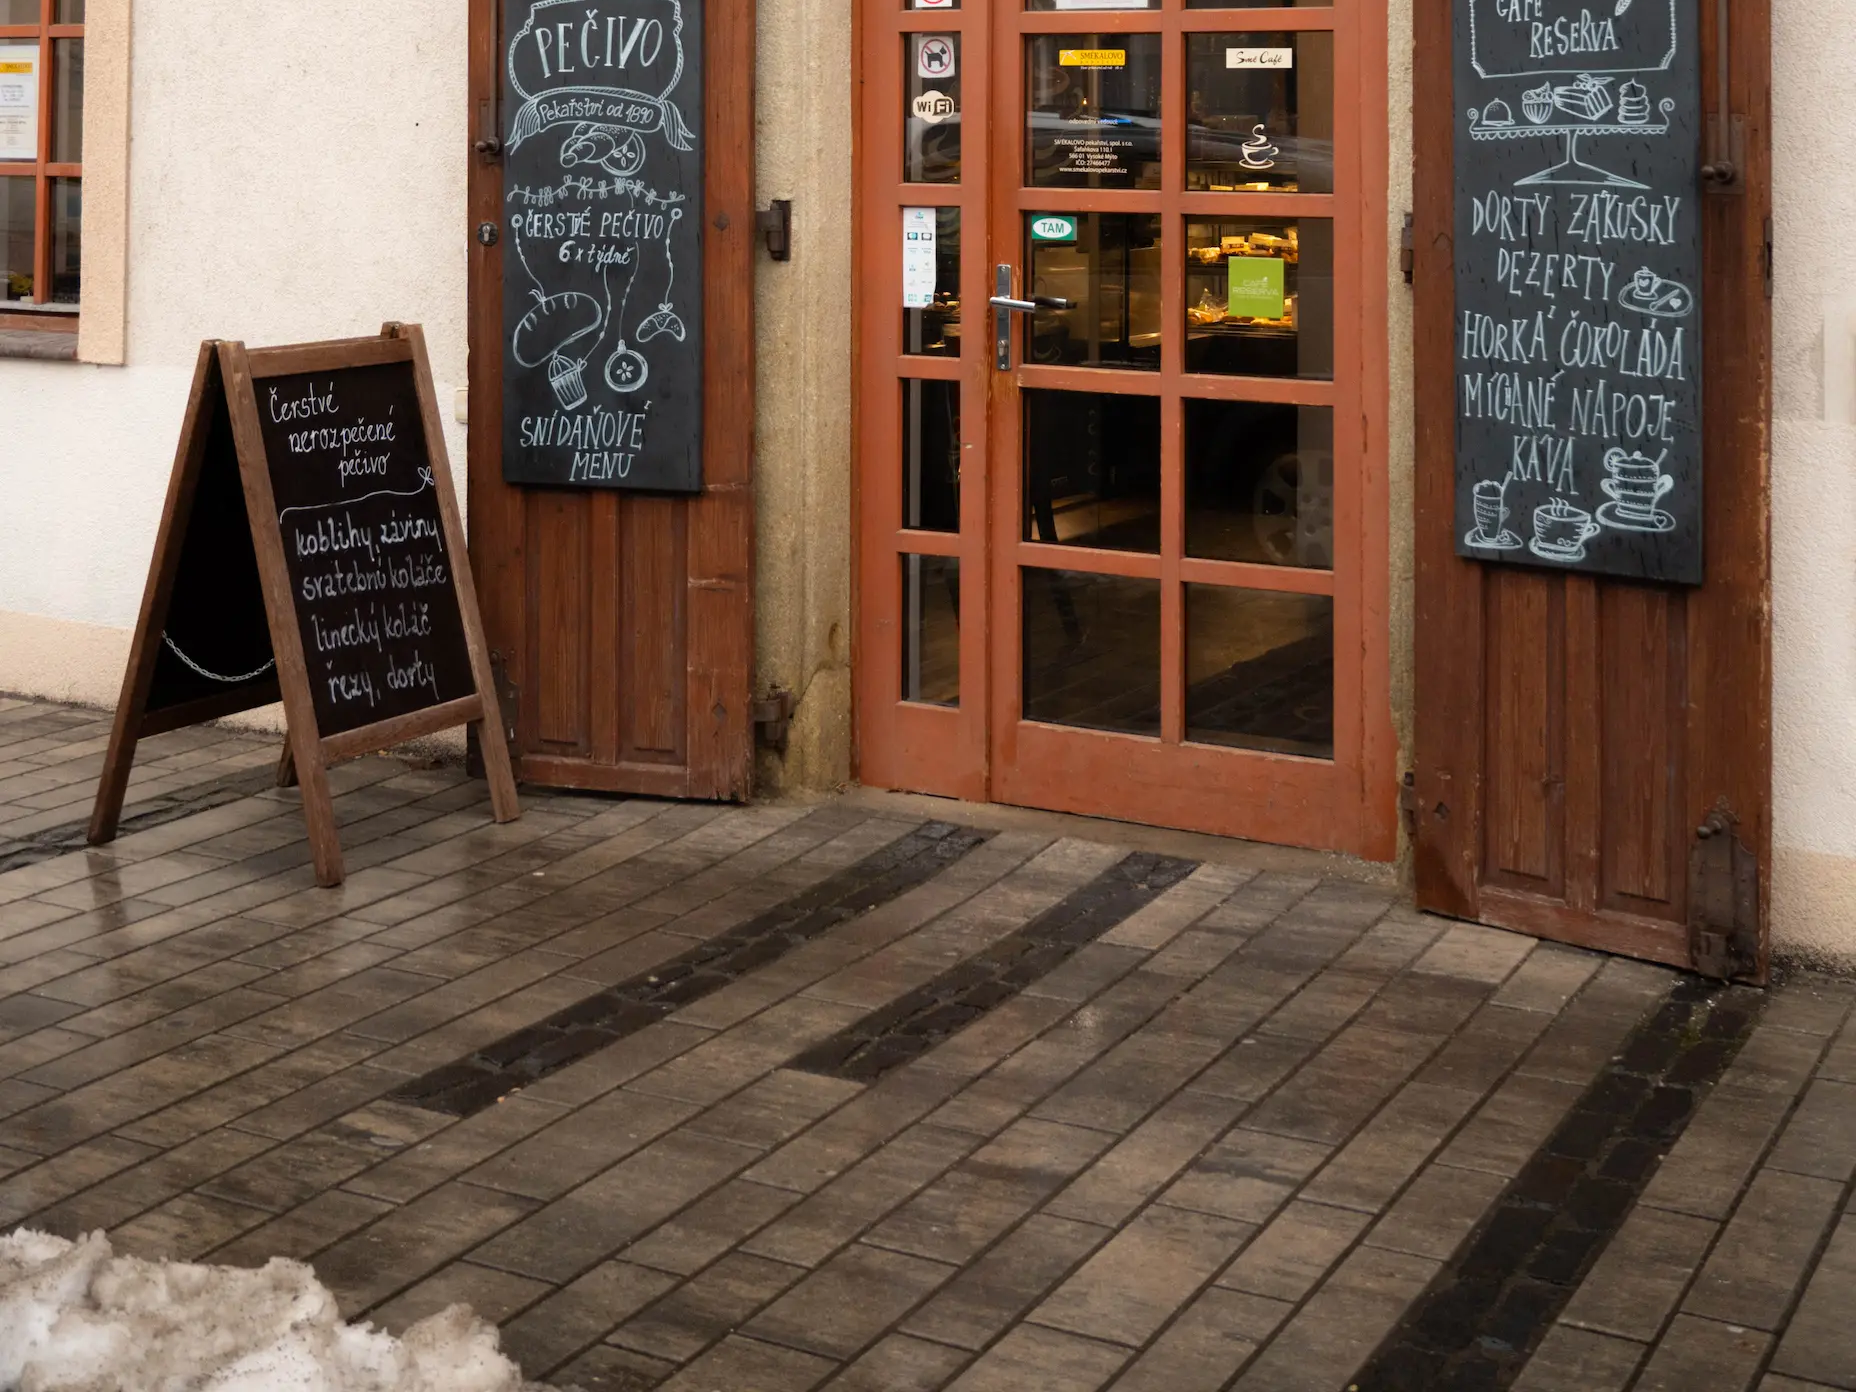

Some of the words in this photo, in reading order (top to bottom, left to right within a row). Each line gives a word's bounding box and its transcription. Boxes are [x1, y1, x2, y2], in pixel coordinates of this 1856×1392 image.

[535, 9, 663, 78] PEČIVO
[1529, 8, 1619, 59] RESERVA
[1259, 50, 1283, 66] Café
[539, 98, 605, 124] Pekařství
[606, 102, 623, 118] od
[626, 102, 654, 124] 1890
[525, 206, 592, 239] ČERSTVÉ
[599, 208, 664, 239] PEČIVO
[1040, 222, 1065, 234] TAM
[1471, 190, 1552, 241] DORTY
[1566, 189, 1681, 245] ZÁKUSKY
[558, 240, 576, 263] 6
[587, 243, 635, 273] týdně
[1496, 247, 1616, 301] DEZERTY
[1461, 304, 1557, 364] HORKÁ
[1560, 310, 1686, 381] ČOKOLÁDA
[269, 381, 340, 423] Čerstvé
[520, 400, 653, 451] SNÍDAŇOVÉ
[338, 451, 391, 488] pečivo
[569, 451, 636, 482] MENU
[1512, 433, 1580, 496] KÁVA
[380, 509, 443, 552] záviny
[302, 556, 386, 601] svatební
[389, 553, 448, 593] koláče
[310, 601, 383, 652] linecký
[384, 602, 432, 639] koláč
[386, 649, 440, 701] dorty
